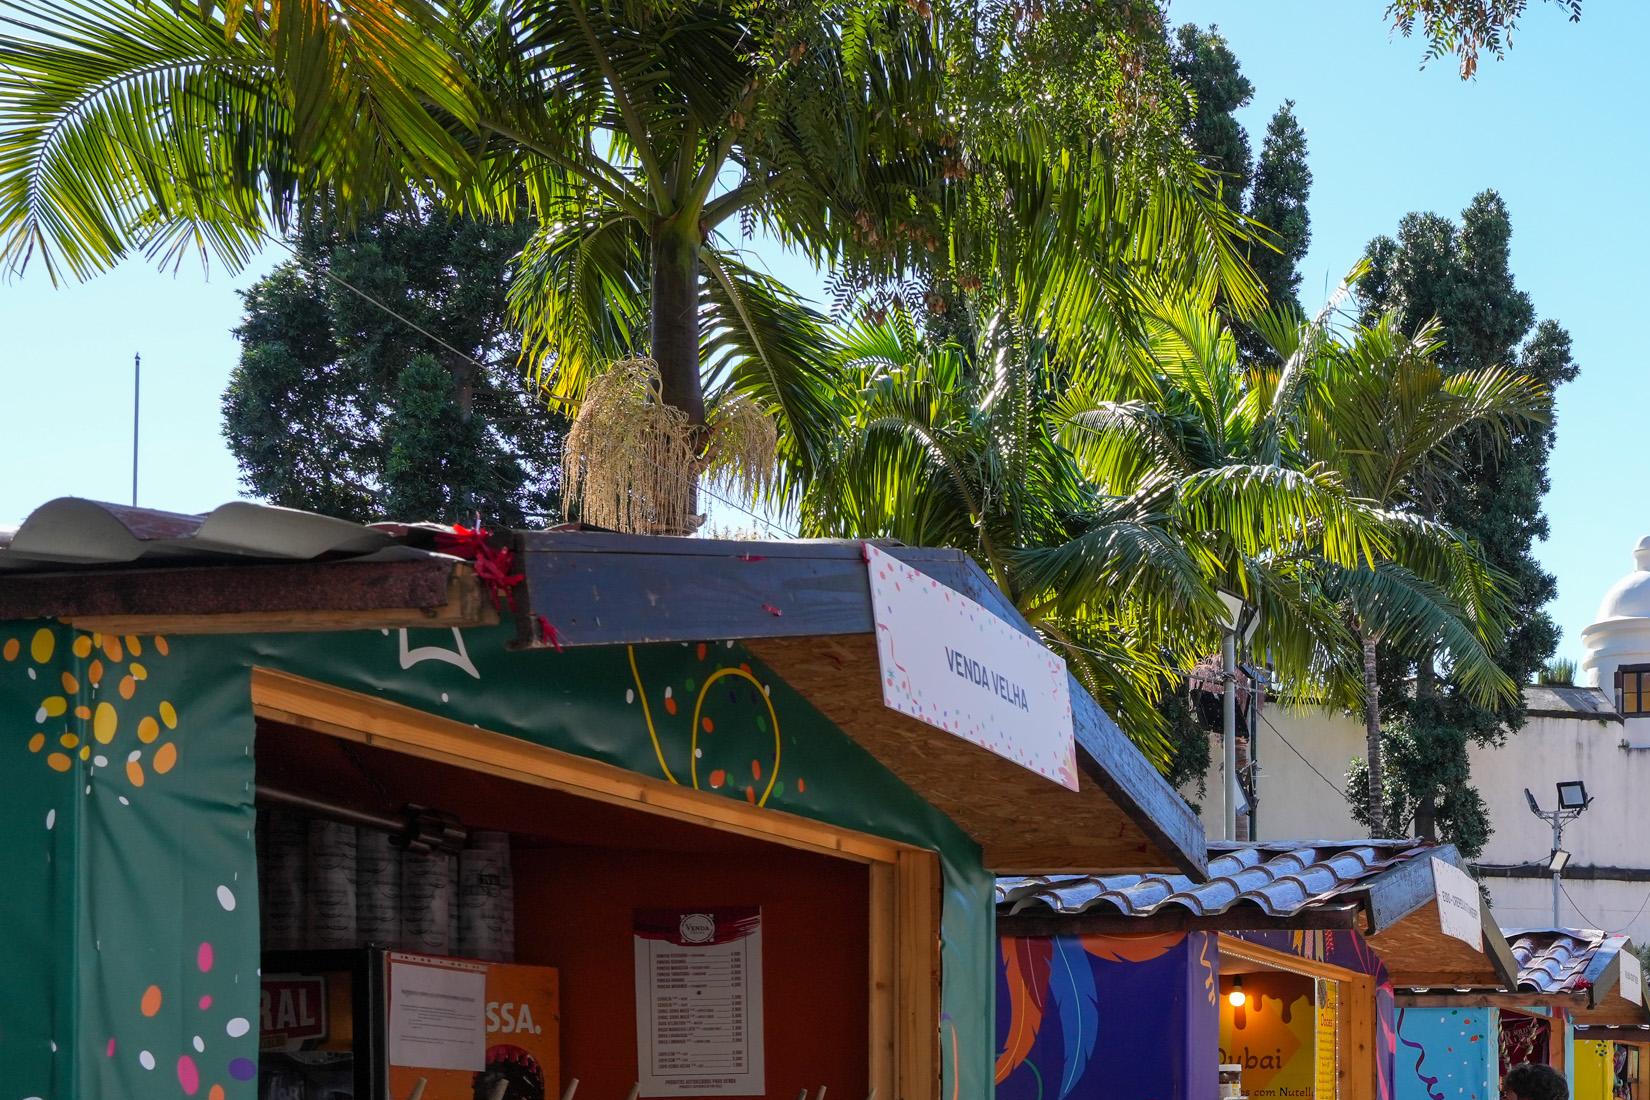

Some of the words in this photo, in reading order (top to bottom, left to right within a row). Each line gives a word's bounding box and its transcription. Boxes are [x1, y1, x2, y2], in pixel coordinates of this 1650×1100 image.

[945, 646, 990, 691] VENDA
[991, 671, 1029, 713] VELHA
[1254, 1089, 1276, 1097] com
